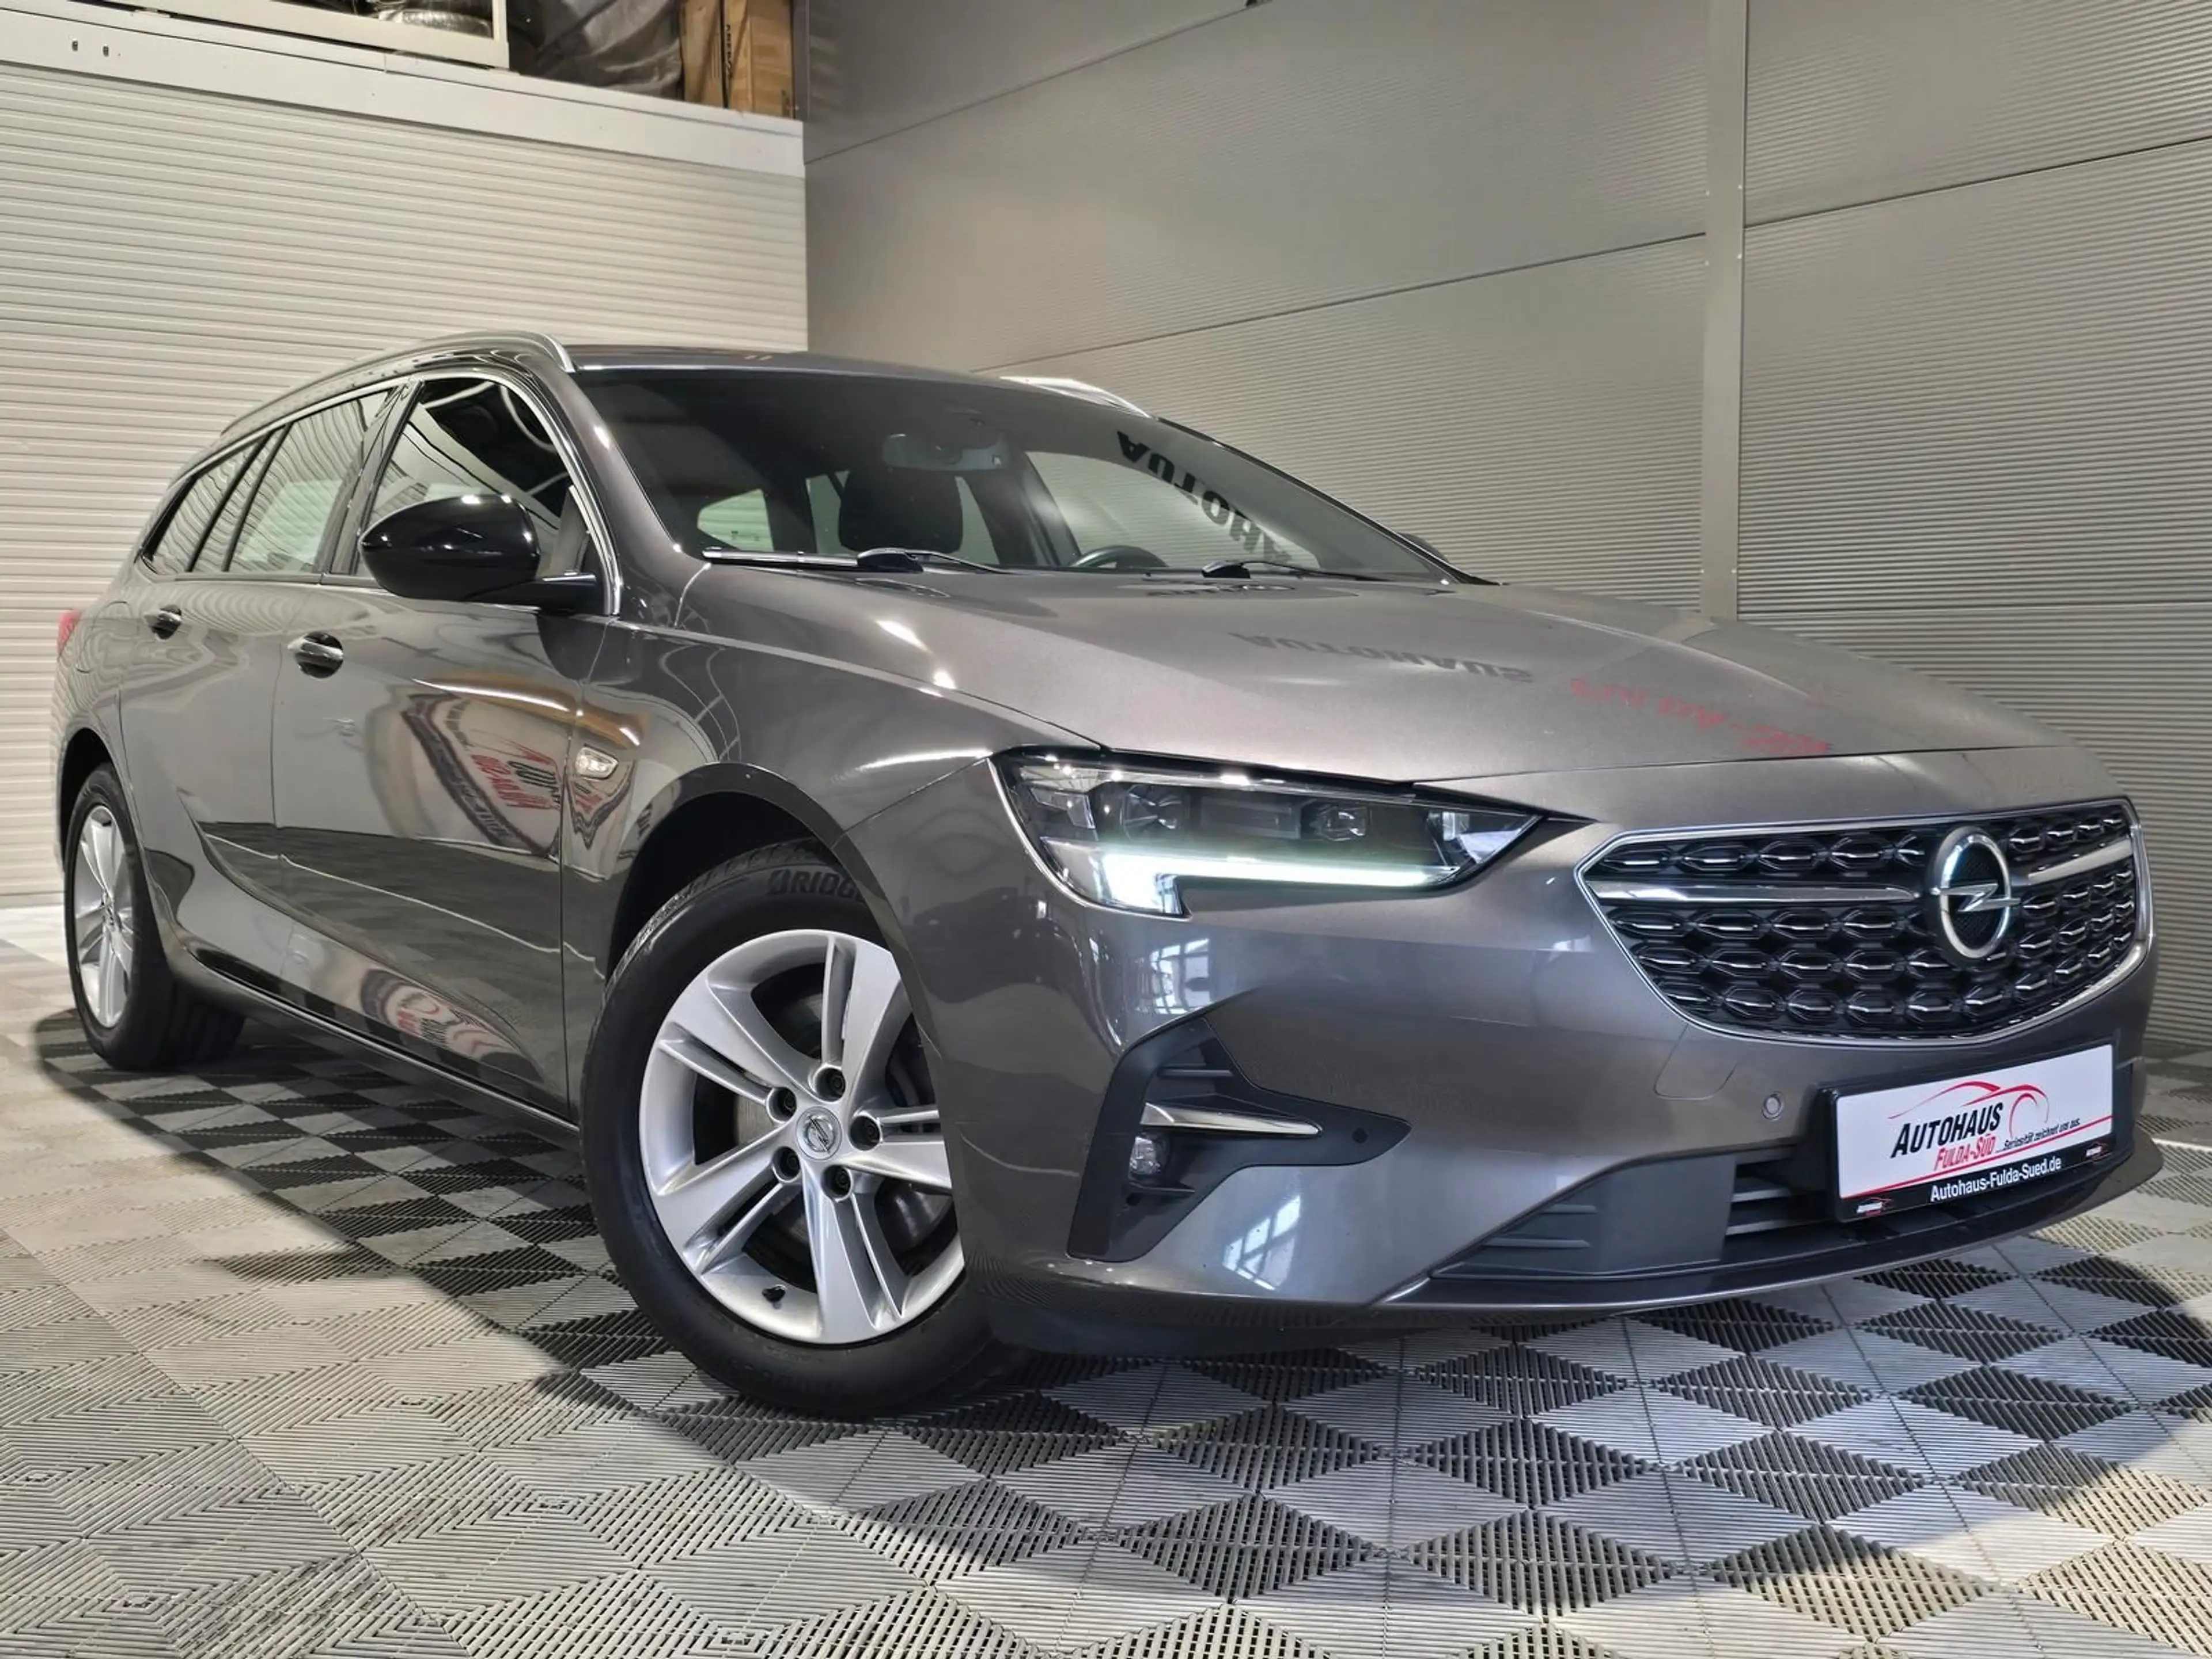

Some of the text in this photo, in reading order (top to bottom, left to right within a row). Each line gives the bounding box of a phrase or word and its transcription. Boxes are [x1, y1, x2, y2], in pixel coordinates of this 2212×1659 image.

[1891, 1101, 2004, 1158] AUTOHAUS
[1934, 1132, 1997, 1171] FULDA-SÜD
[1931, 1156, 2062, 1202] Autohaus-Fulda-Sued.de
